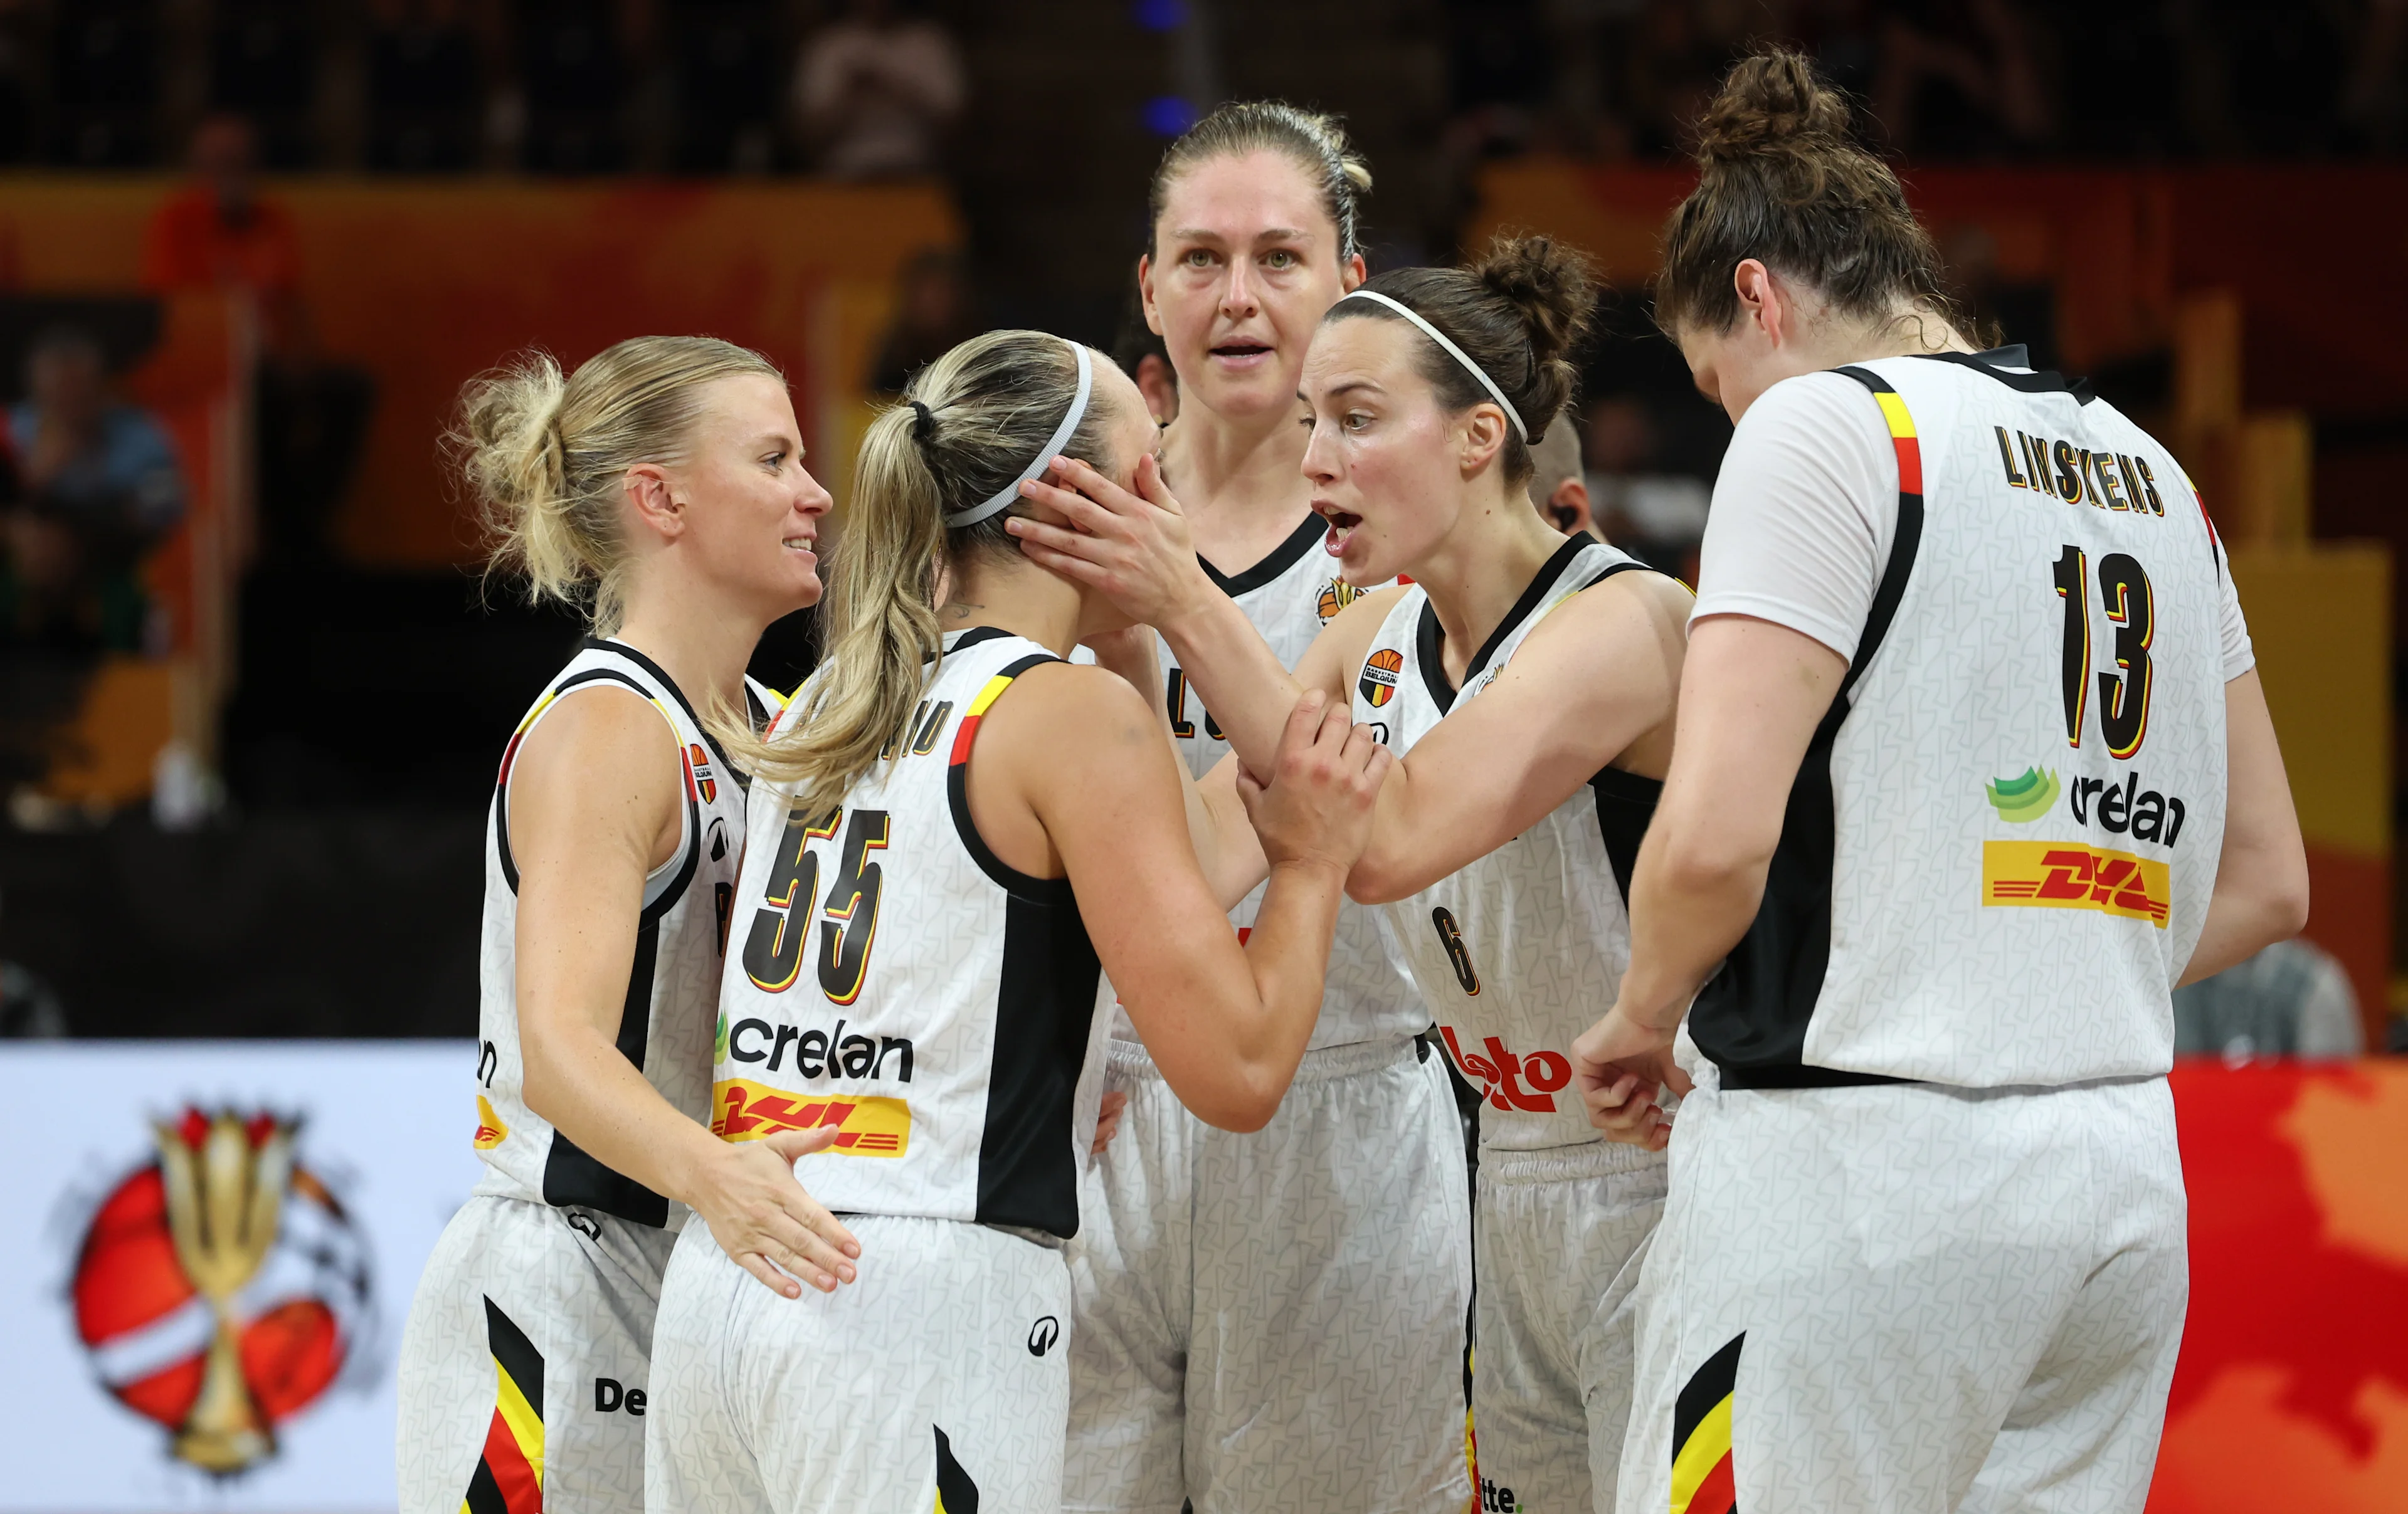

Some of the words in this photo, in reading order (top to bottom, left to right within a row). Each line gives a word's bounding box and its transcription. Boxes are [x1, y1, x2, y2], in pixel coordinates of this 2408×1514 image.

[1994, 426, 2165, 517] LINSKENS
[2052, 544, 2155, 760] 13
[2071, 771, 2185, 848] crelan
[742, 794, 890, 1006] 55
[2036, 850, 2152, 912] DHL
[1432, 907, 1481, 996] 6
[730, 1018, 914, 1083] crelan
